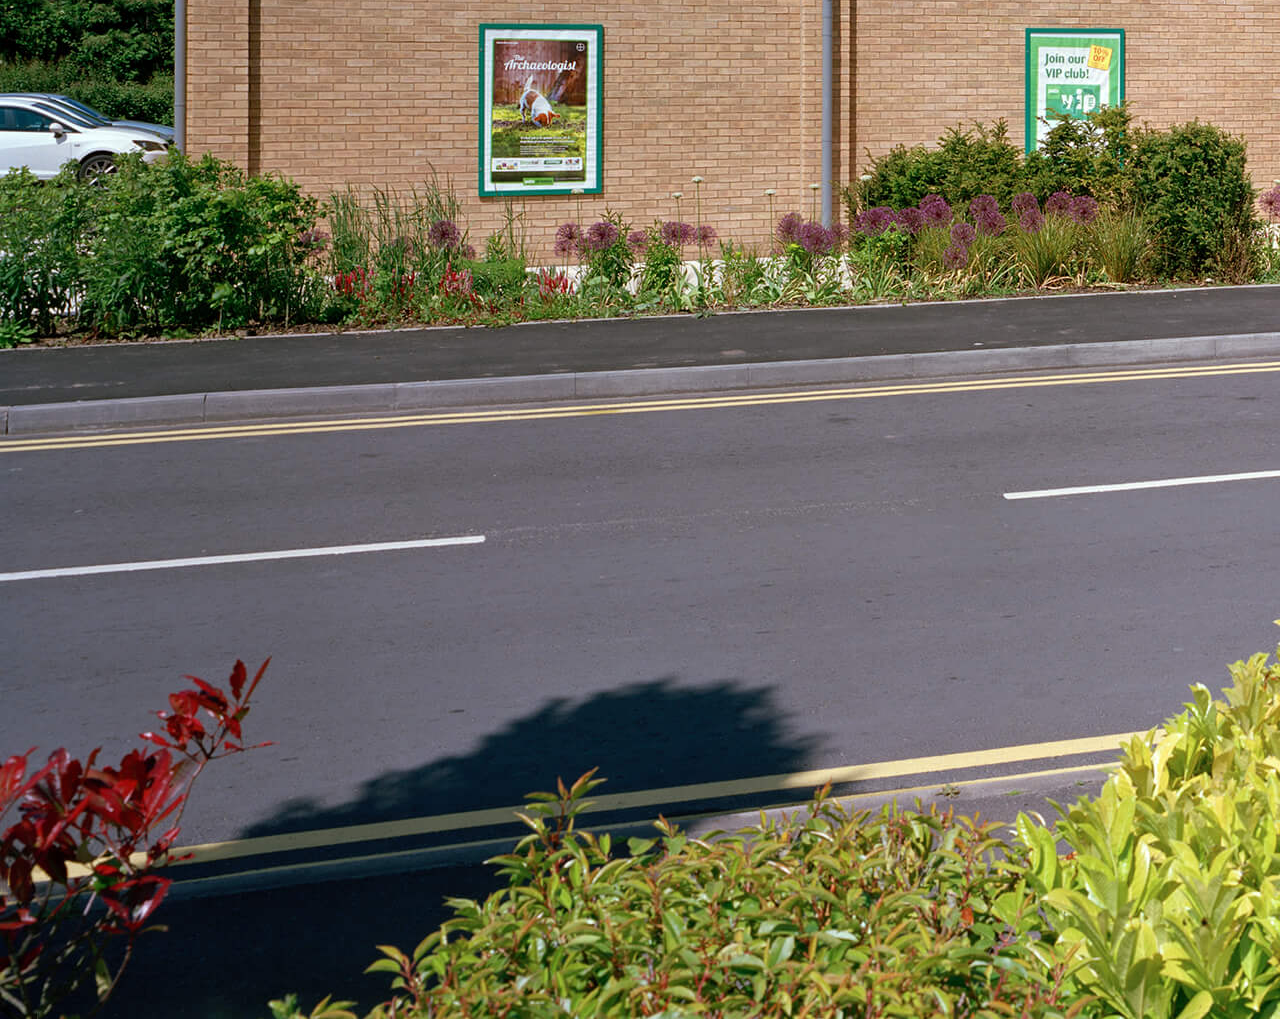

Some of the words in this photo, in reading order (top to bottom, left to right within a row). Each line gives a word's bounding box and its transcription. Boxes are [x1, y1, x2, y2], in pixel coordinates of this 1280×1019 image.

[503, 59, 577, 73] Archaeologist
[1044, 53, 1065, 66] Join
[1068, 55, 1086, 64] our
[1045, 68, 1062, 78] VIP
[1064, 68, 1089, 79] club!
